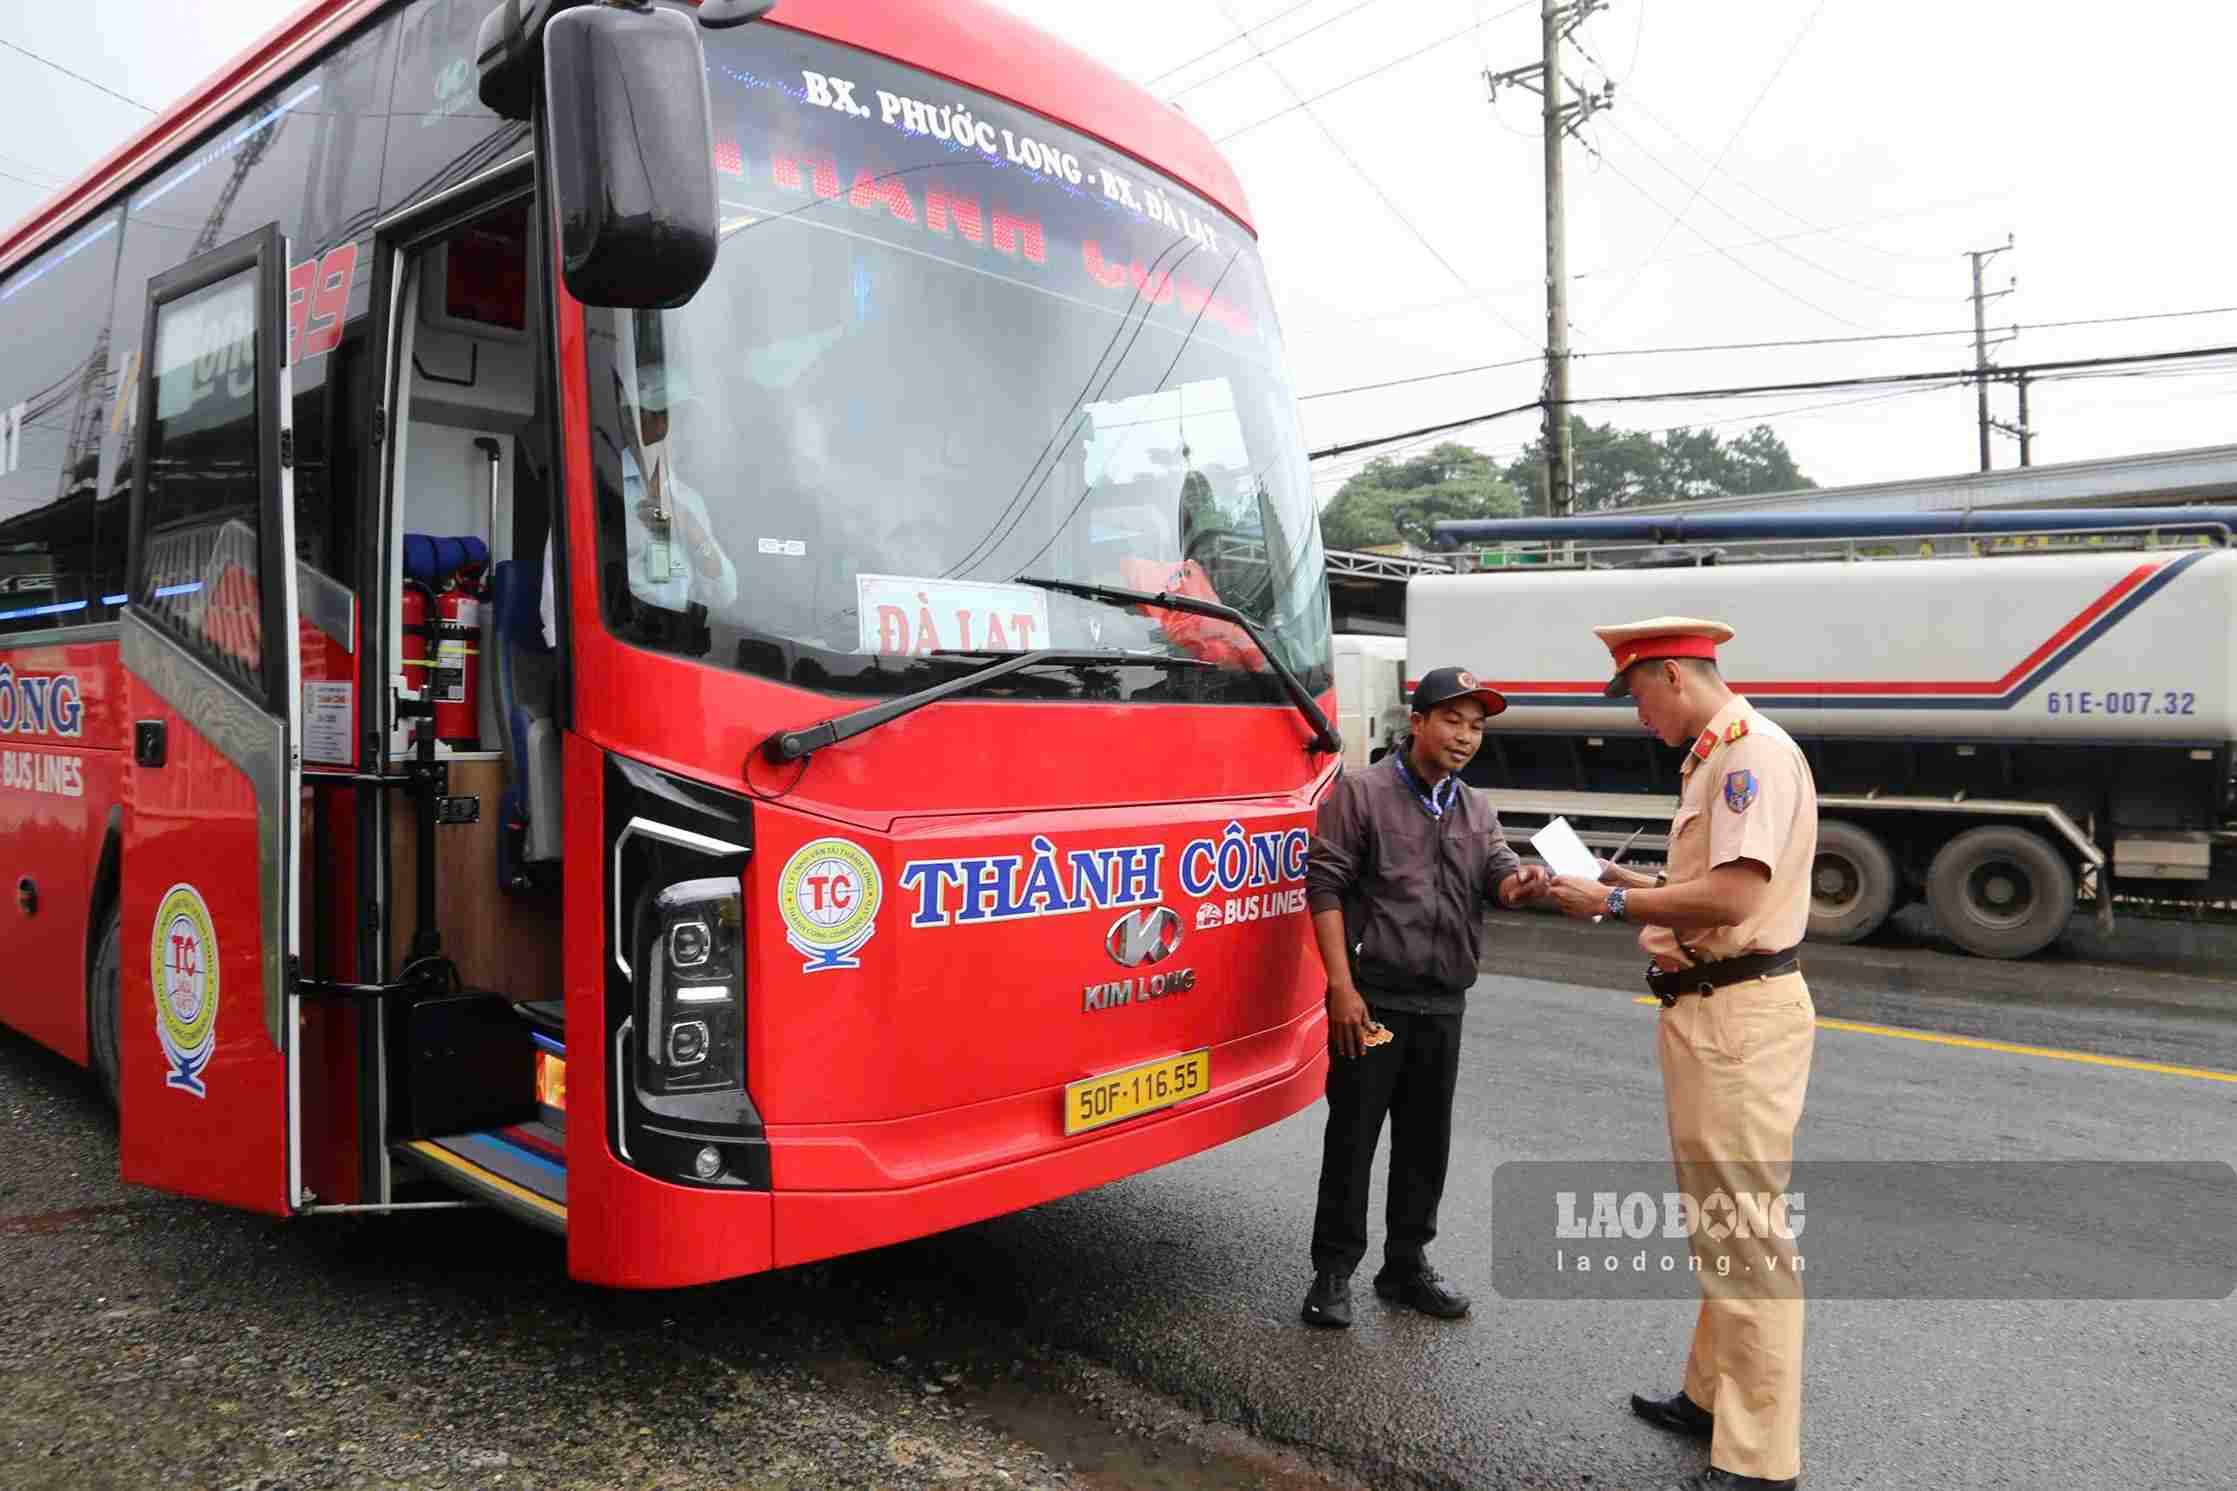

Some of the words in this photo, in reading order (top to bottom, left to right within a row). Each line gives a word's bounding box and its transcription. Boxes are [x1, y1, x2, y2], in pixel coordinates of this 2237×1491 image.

[802, 70, 871, 118] BX.
[876, 89, 997, 153] PHƯỚC
[1001, 128, 1082, 183] LONG
[876, 592, 943, 656] ĐÀ
[2047, 691, 2196, 715] 61E-007.32
[3, 751, 32, 790] BUS
[34, 753, 83, 797] LINES
[807, 874, 851, 911] TC
[899, 835, 1166, 928] THÀNH
[1179, 819, 1312, 897] CÔNG
[1224, 895, 1260, 925] BUS
[1262, 887, 1308, 918] LINES
[171, 935, 196, 977] TC
[1081, 978, 1133, 1013] KIM
[1136, 967, 1196, 1003] LONG
[1080, 1060, 1199, 1121] 50F-116.55
